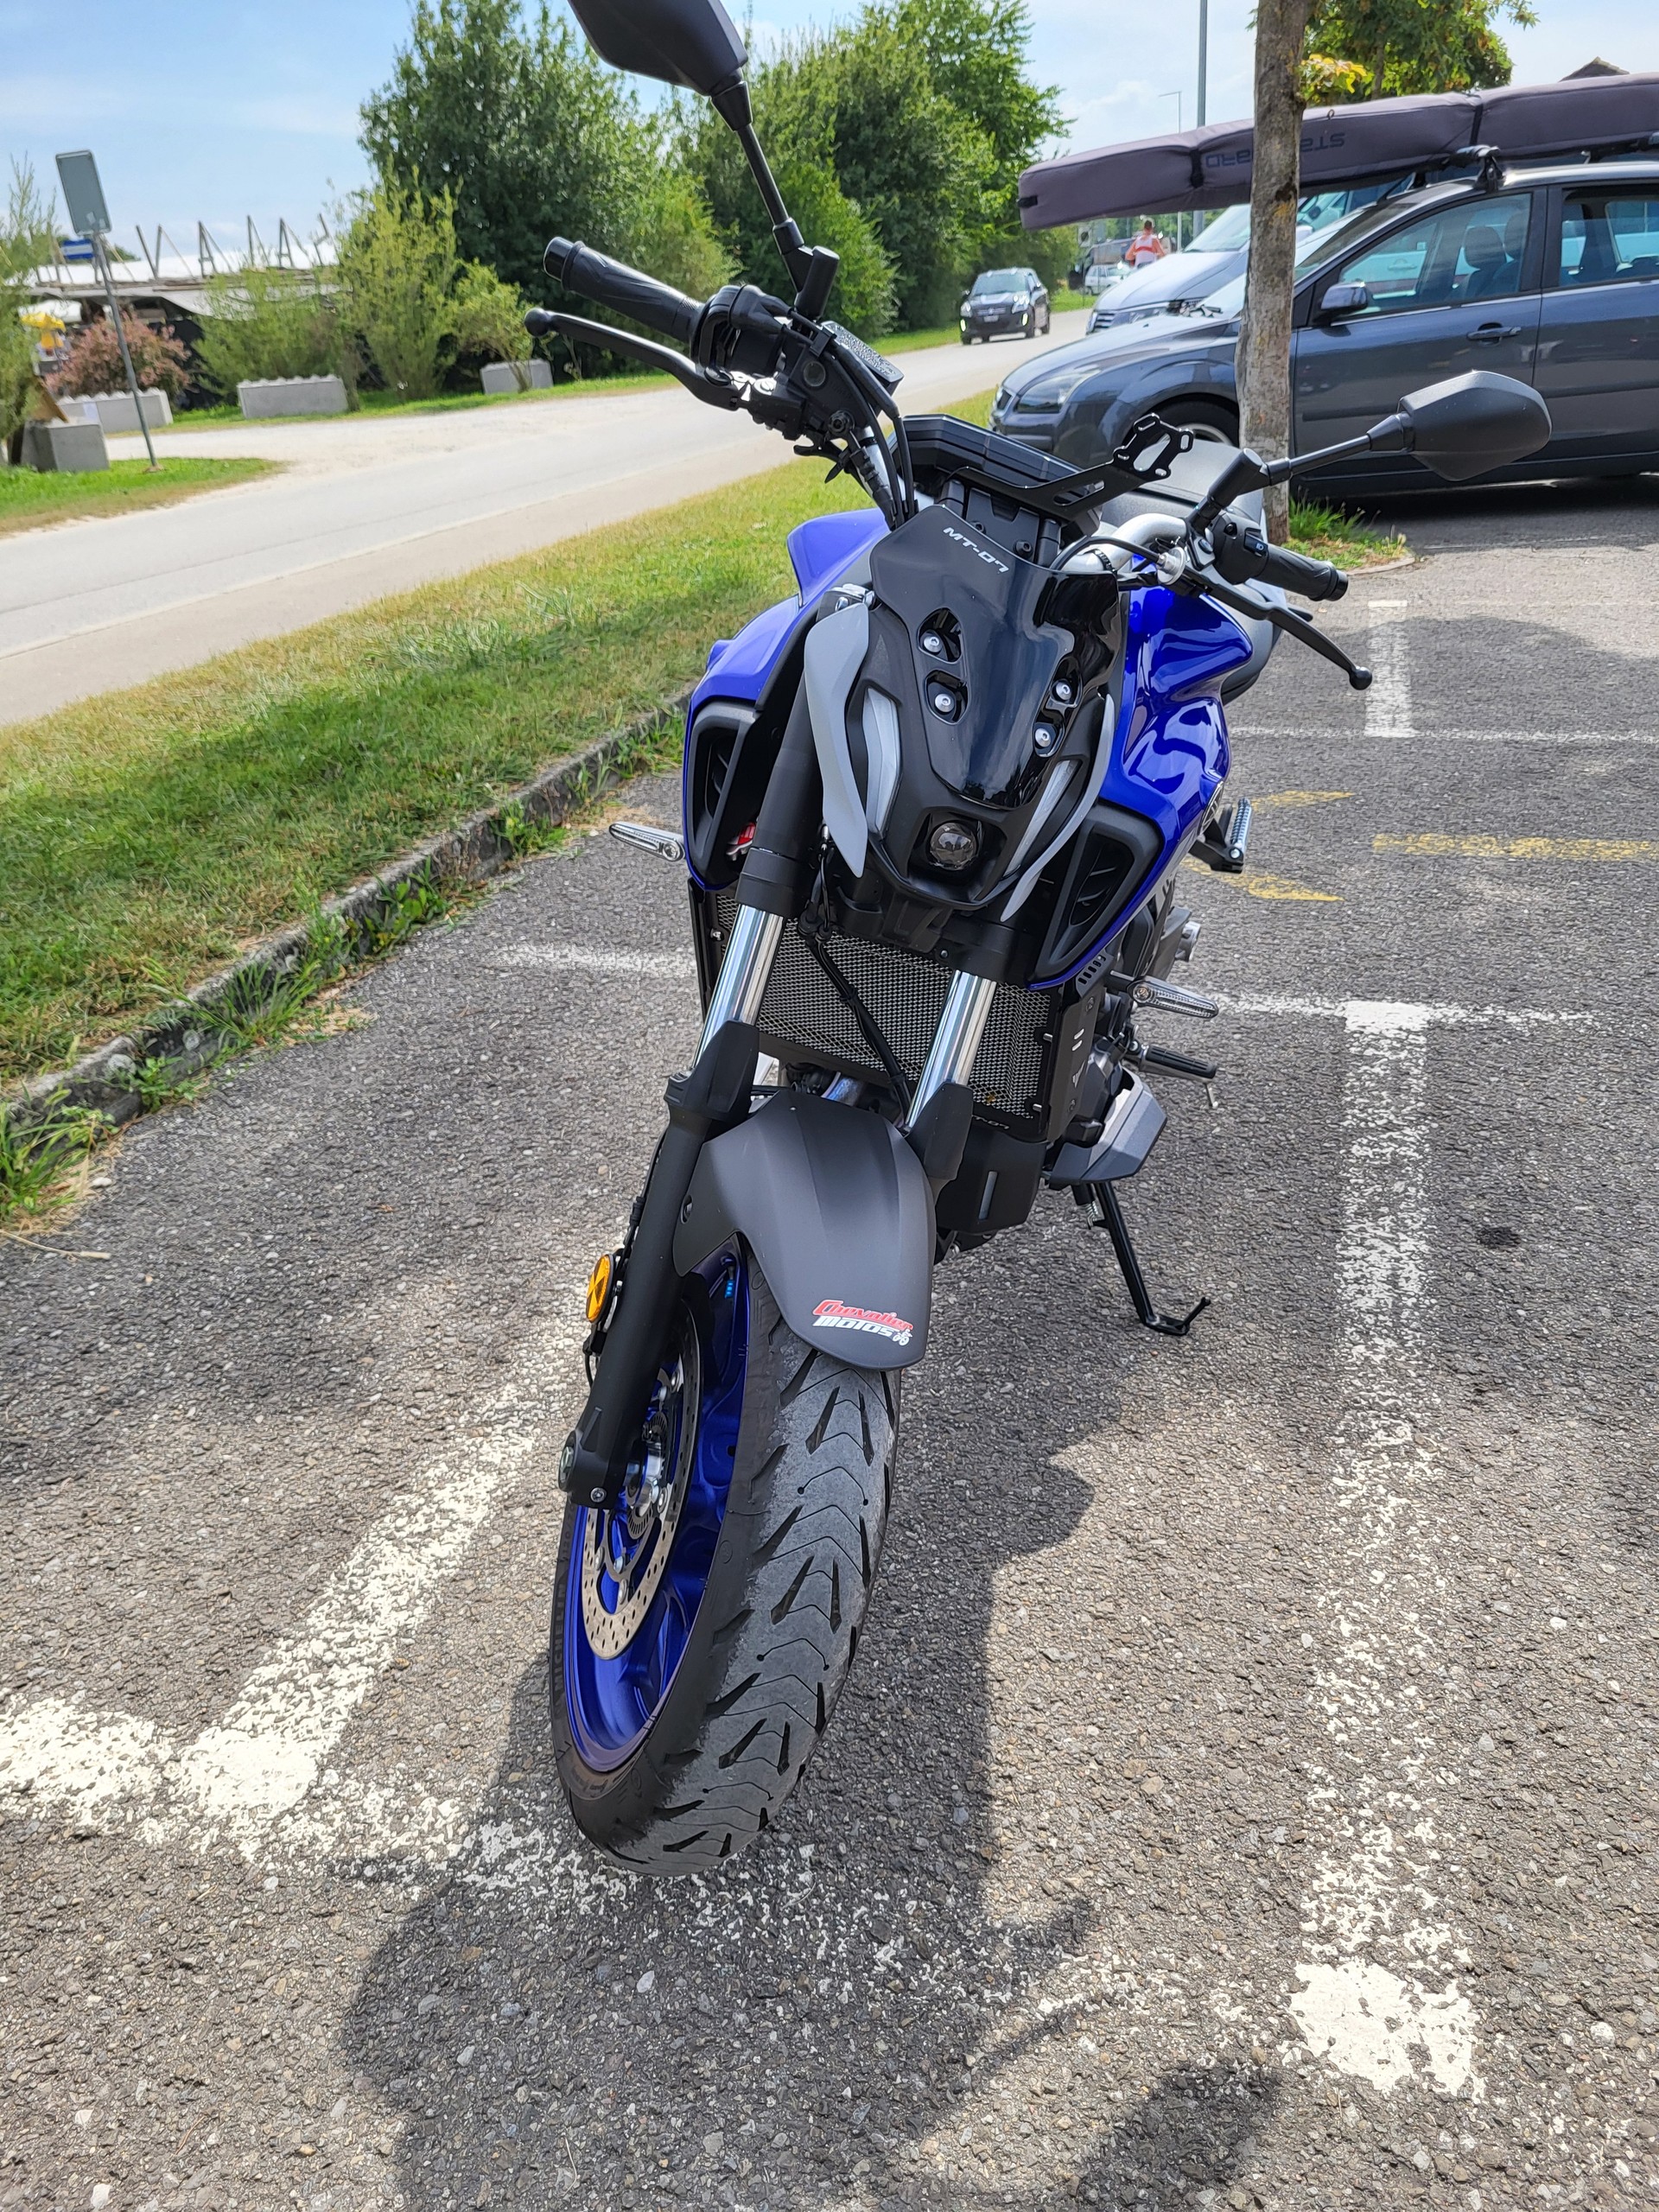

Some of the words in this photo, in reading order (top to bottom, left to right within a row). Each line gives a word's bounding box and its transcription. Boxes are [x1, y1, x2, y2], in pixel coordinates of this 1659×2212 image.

[943, 527, 1009, 573] MT-07
[812, 1299, 913, 1332] Chevalier
[812, 1316, 899, 1337] MOTOS
